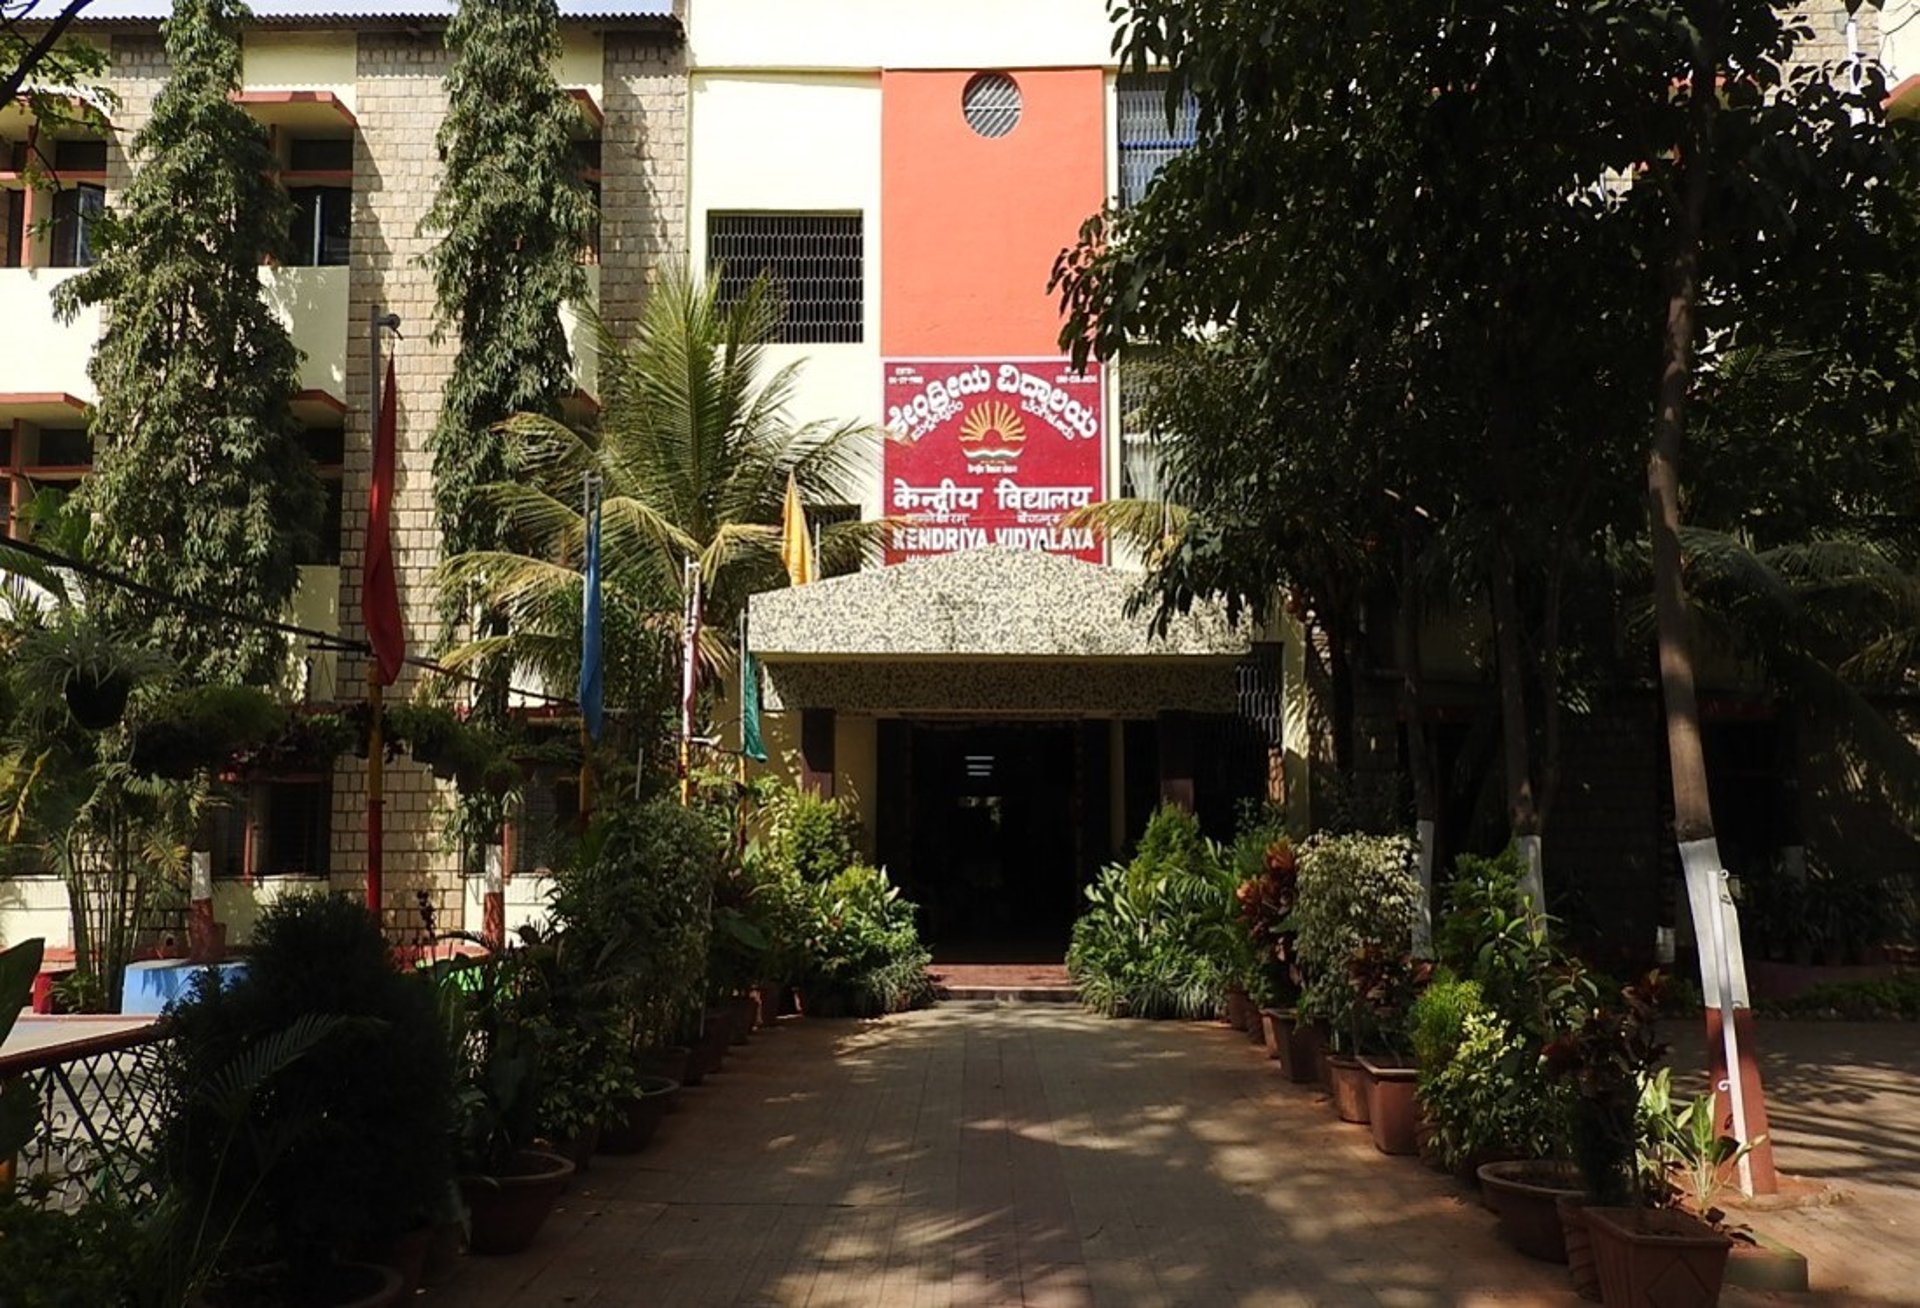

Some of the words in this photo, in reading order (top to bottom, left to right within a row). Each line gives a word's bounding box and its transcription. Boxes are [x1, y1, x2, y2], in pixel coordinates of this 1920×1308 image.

[893, 478, 984, 512] केन्द्रीय
[994, 478, 1093, 510] विद्यालय
[892, 527, 988, 551] KENDRIYA
[994, 527, 1095, 551] VIDYALAYA
